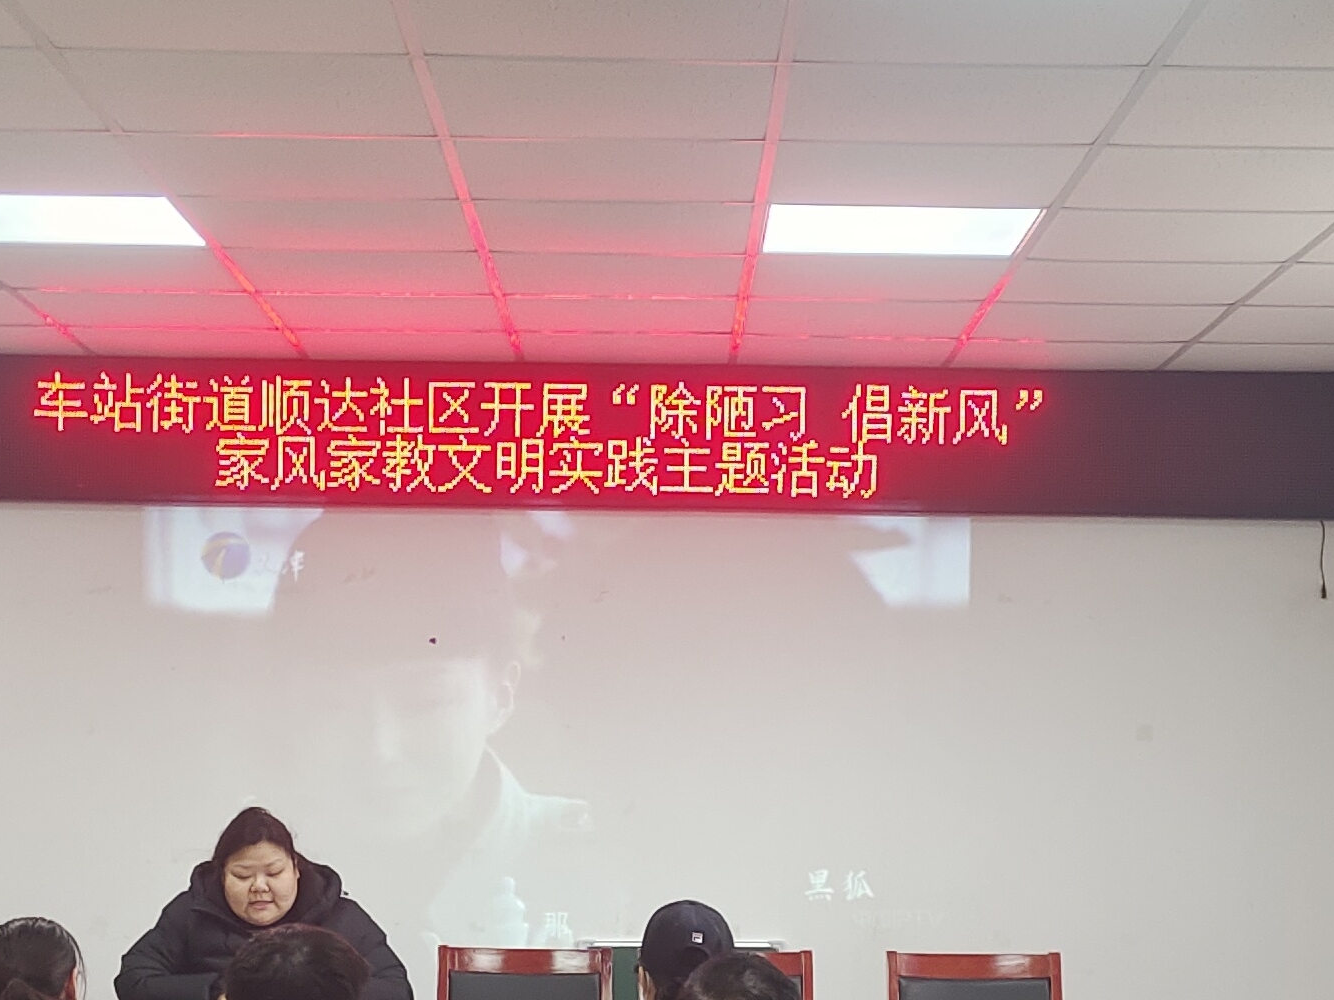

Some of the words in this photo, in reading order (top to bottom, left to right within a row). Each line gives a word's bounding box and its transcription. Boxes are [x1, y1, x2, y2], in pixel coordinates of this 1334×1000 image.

[215, 433, 878, 499] 家风家教文明实践主题活动
[802, 868, 875, 903] 黑狐
